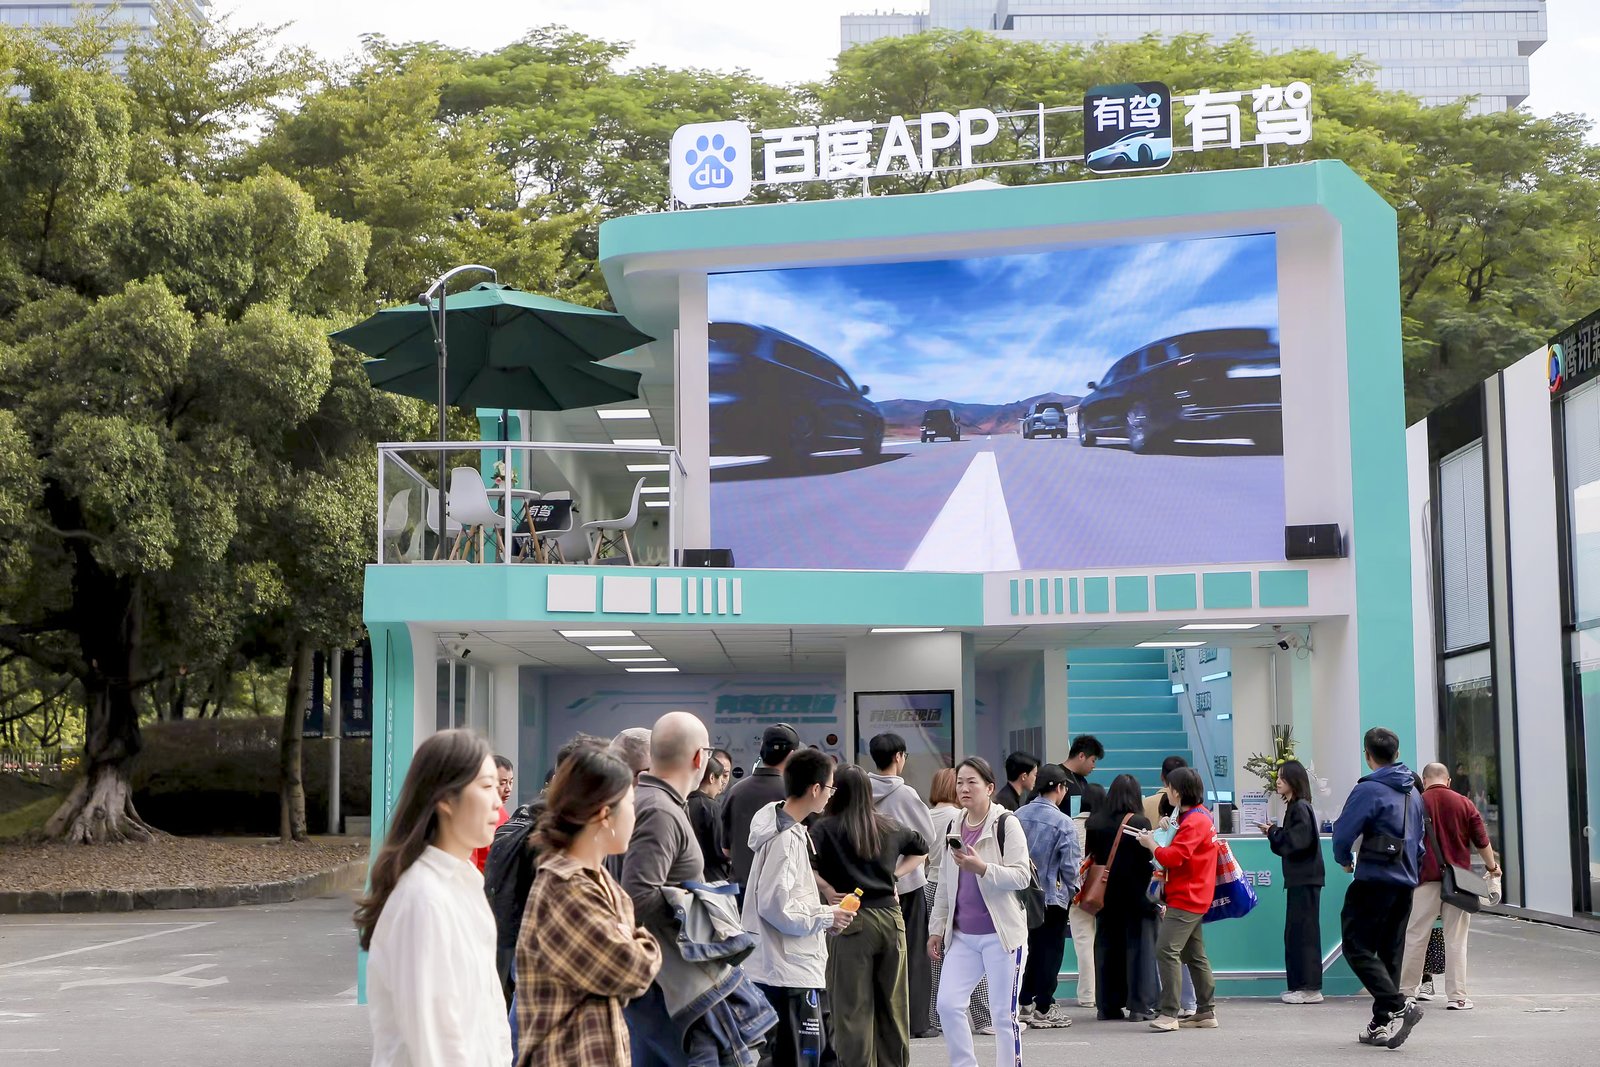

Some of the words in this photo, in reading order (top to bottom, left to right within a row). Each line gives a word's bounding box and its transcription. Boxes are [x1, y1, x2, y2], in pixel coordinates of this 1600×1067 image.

[1093, 93, 1161, 132] 有驾
[1184, 81, 1312, 152] 有驾
[762, 108, 999, 183] 百度APP
[695, 163, 725, 185] du
